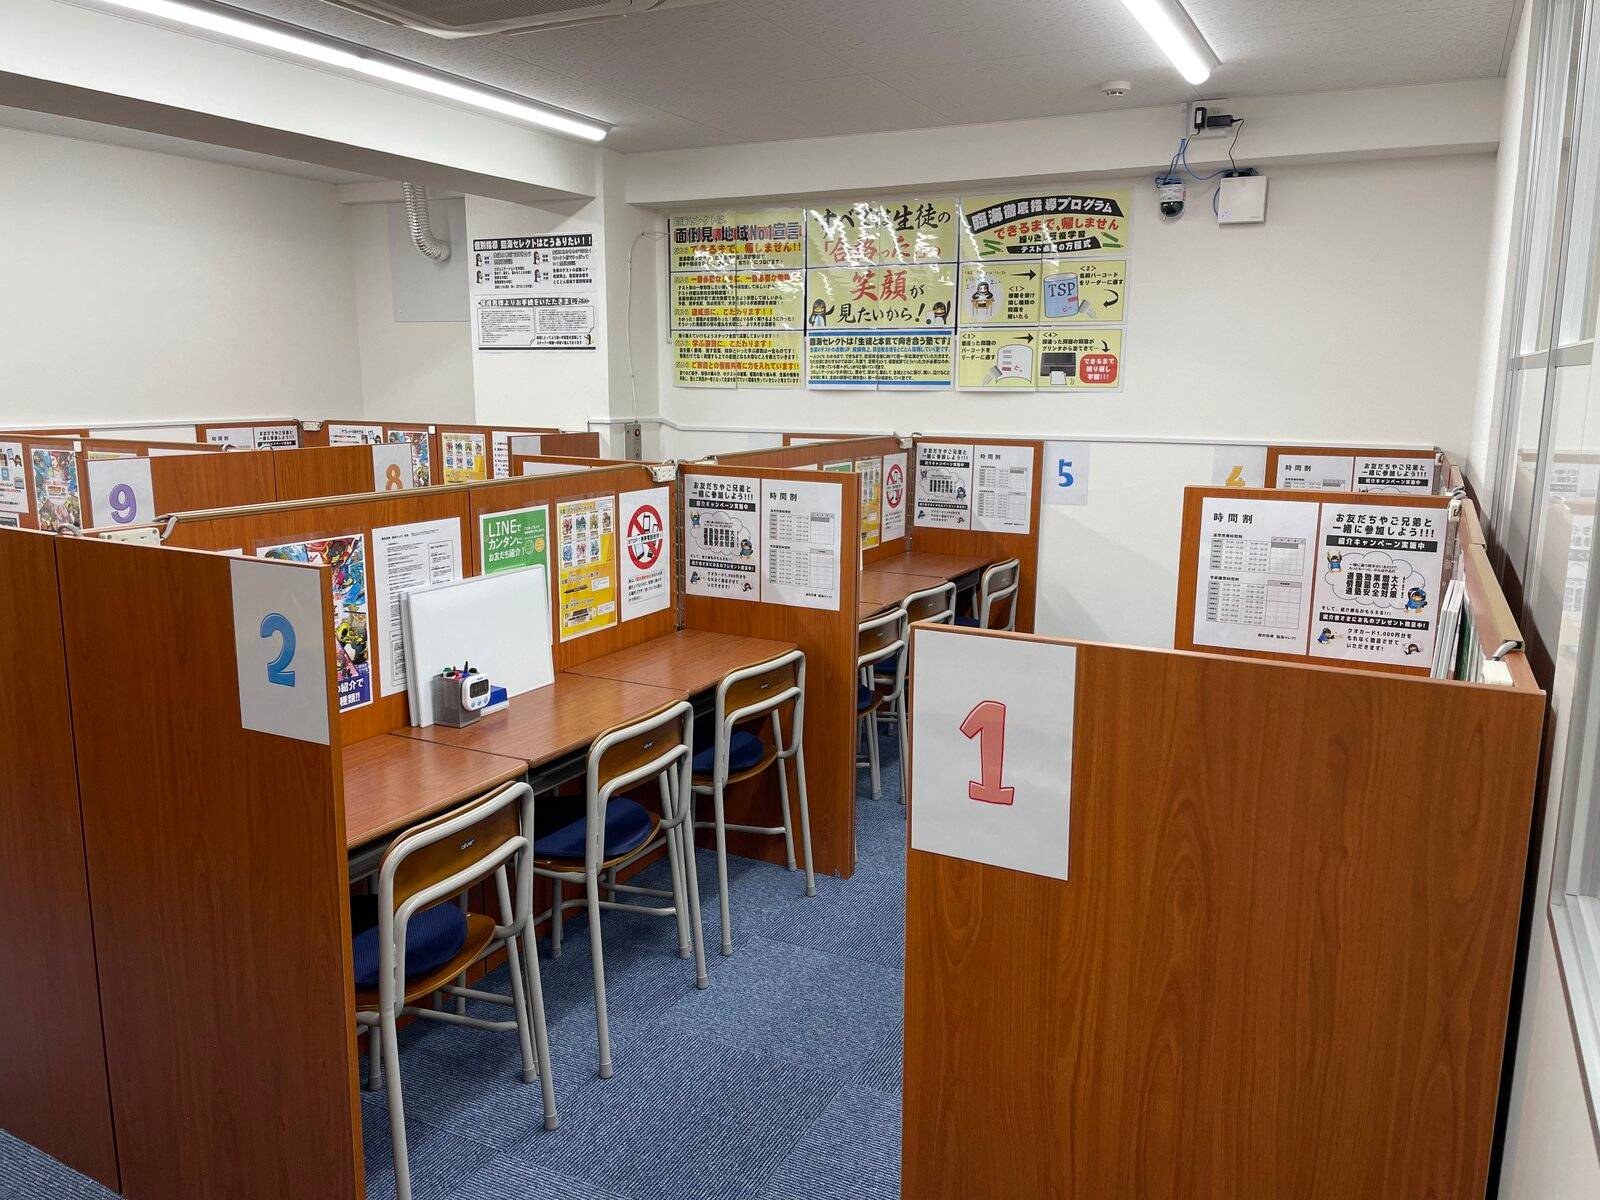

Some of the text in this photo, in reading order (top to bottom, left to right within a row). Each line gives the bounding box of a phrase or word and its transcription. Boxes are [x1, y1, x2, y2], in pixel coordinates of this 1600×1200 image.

[851, 269, 925, 302] 笑顔が
[1048, 282, 1076, 298] TSP
[1058, 459, 1074, 488] 5
[1363, 463, 1426, 471] お友だちやご兄弟と
[385, 463, 404, 491] 8
[693, 481, 752, 493] お友だちやご兄弟と
[109, 483, 137, 524] 9
[769, 492, 798, 502] 時間割
[1213, 512, 1253, 524] 時間割
[1336, 513, 1432, 528] お友だちやご兄弟と
[488, 518, 522, 537] LINEで
[1332, 524, 1435, 538] 一緒に参加しよう!!!
[488, 536, 523, 551] カンタンに
[1338, 538, 1425, 550] 紹介キャンペーン実施中
[1347, 628, 1412, 639] クオカード1,000円分を
[259, 612, 296, 687] 2
[1346, 644, 1384, 652] いただきます!
[959, 700, 1016, 806] 1
